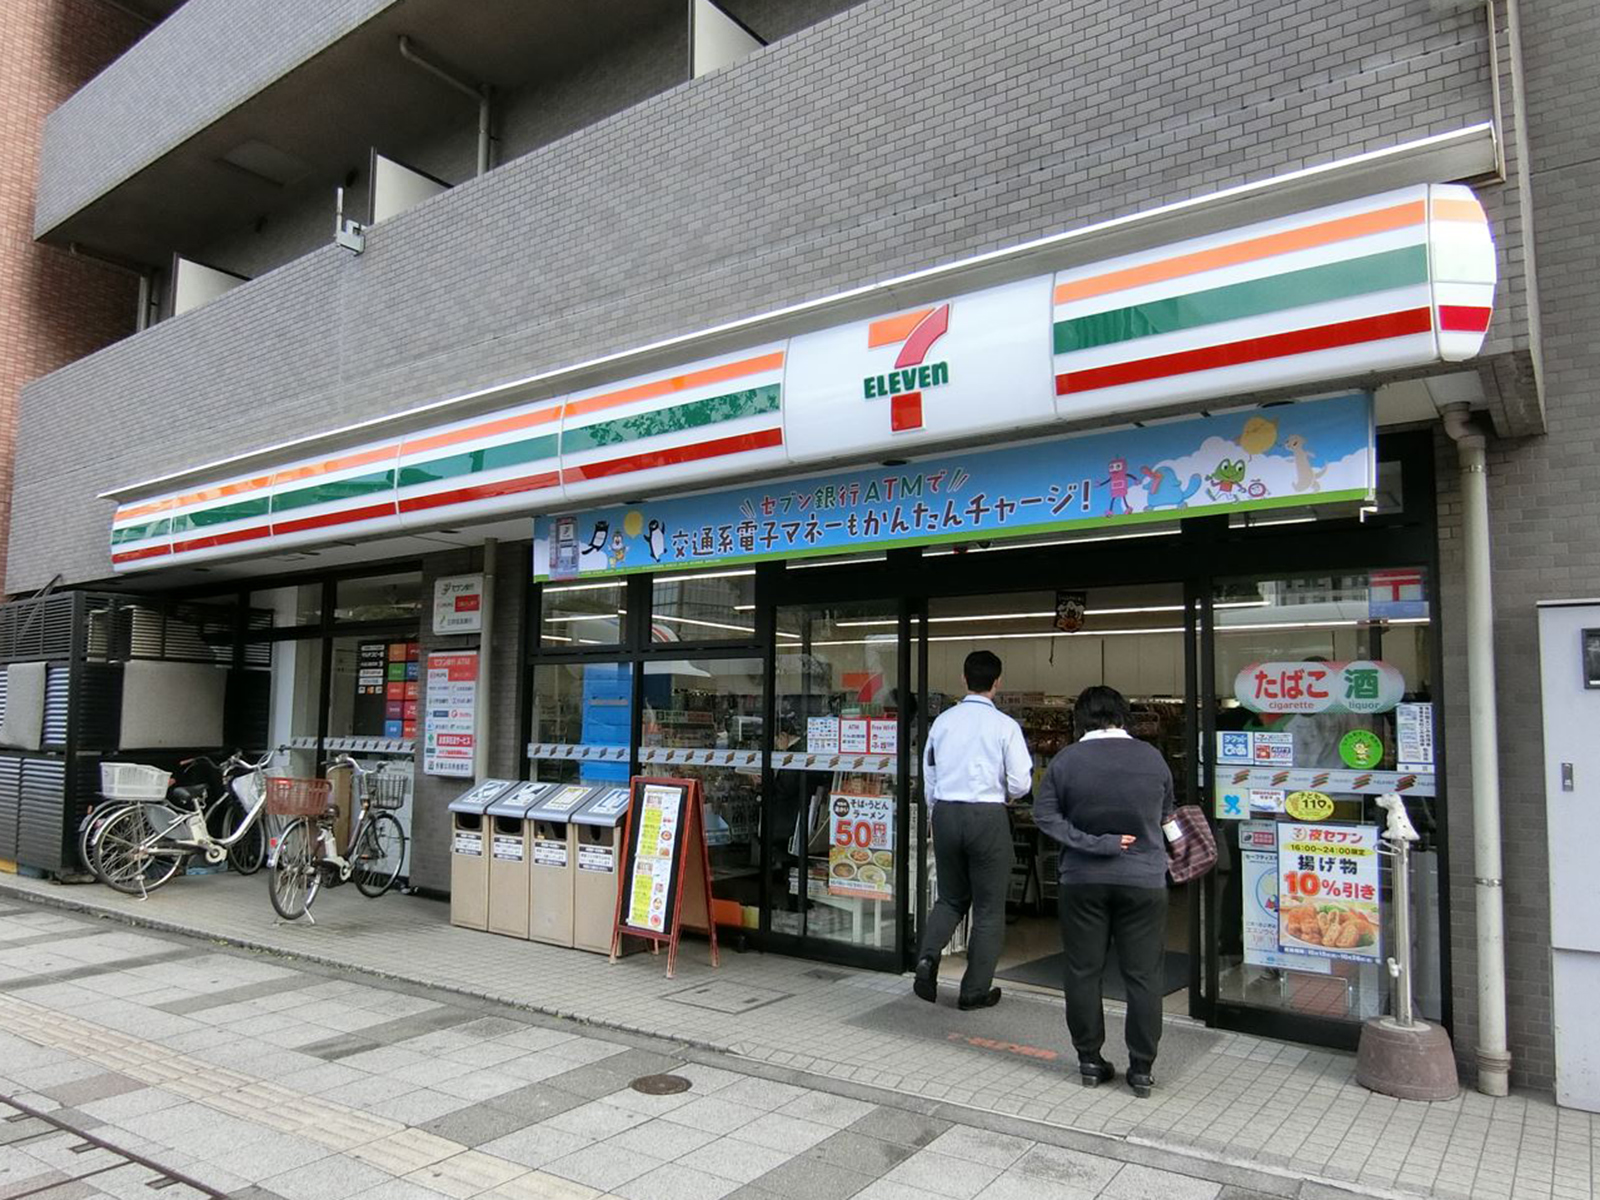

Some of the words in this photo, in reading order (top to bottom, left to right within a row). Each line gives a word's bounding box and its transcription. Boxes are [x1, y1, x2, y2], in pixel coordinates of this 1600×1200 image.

[761, 470, 946, 516] セブン銀行ATMで
[671, 480, 1092, 559] 交通系電子マネーもかんたんチャージ!
[1254, 668, 1329, 699] たばこ
[1344, 668, 1380, 699] 酒
[1268, 701, 1315, 710] cigarette
[1349, 701, 1380, 710] liquor
[850, 799, 889, 810] そば・うどん
[853, 810, 886, 820] ラーメン
[1309, 828, 1363, 844] 夜セブン
[1298, 854, 1358, 875] 揚げ物
[1283, 871, 1376, 900] 10%引き
